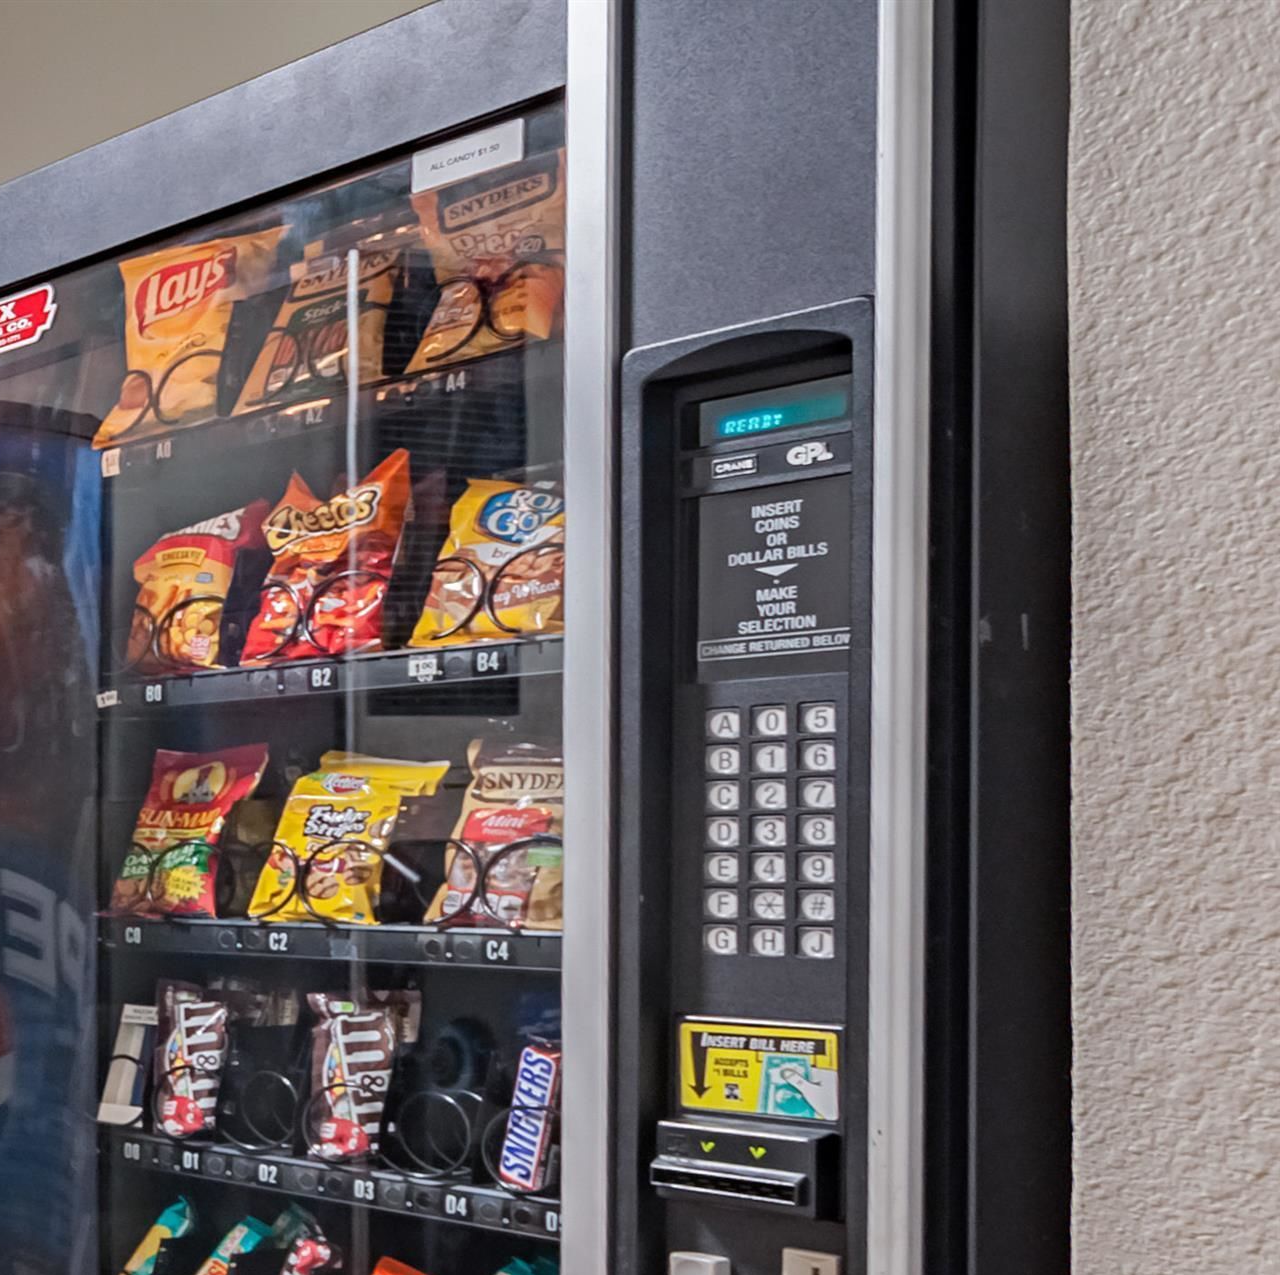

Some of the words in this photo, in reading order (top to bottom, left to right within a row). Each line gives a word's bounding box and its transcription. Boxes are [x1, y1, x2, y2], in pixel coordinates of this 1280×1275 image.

[7, 318, 32, 333] CO.
[446, 371, 466, 392] A4
[306, 408, 323, 425] A2
[724, 414, 783, 434] READY
[715, 460, 754, 474] CRANE
[751, 499, 804, 518] INSERT
[755, 516, 800, 533] COINS
[766, 532, 787, 547] OR
[728, 549, 783, 567] DOLLAR
[787, 542, 828, 560] BILLS
[756, 586, 798, 602] MAKE
[757, 601, 796, 617] YOUR
[738, 615, 816, 635] SELECTION
[702, 642, 747, 657] CHANGE
[749, 637, 810, 654] RETURNED
[476, 651, 499, 672] B4
[311, 667, 331, 687] B2
[717, 715, 733, 733] A
[765, 712, 778, 731] 0
[814, 709, 827, 728] 5
[719, 752, 732, 770] B
[767, 750, 775, 768] 1
[813, 747, 827, 766] 6
[718, 786, 732, 805] C
[764, 786, 777, 804] 2
[813, 785, 826, 803] 7
[718, 823, 732, 841] D
[763, 822, 776, 841] 3
[812, 822, 826, 840] 8
[718, 859, 730, 877] E
[762, 859, 776, 877] 4
[812, 859, 825, 877] 9
[717, 895, 729, 912] F
[810, 897, 826, 916] #
[269, 932, 288, 951] C2
[486, 940, 509, 961] C4
[715, 931, 729, 949] G
[761, 932, 776, 950] H
[811, 934, 824, 953] J
[701, 1032, 746, 1048] INSERT
[749, 1038, 776, 1051] BILL
[780, 1040, 815, 1053] HERE
[502, 1051, 554, 1182] SNICKERS
[545, 1211, 562, 1234] D
